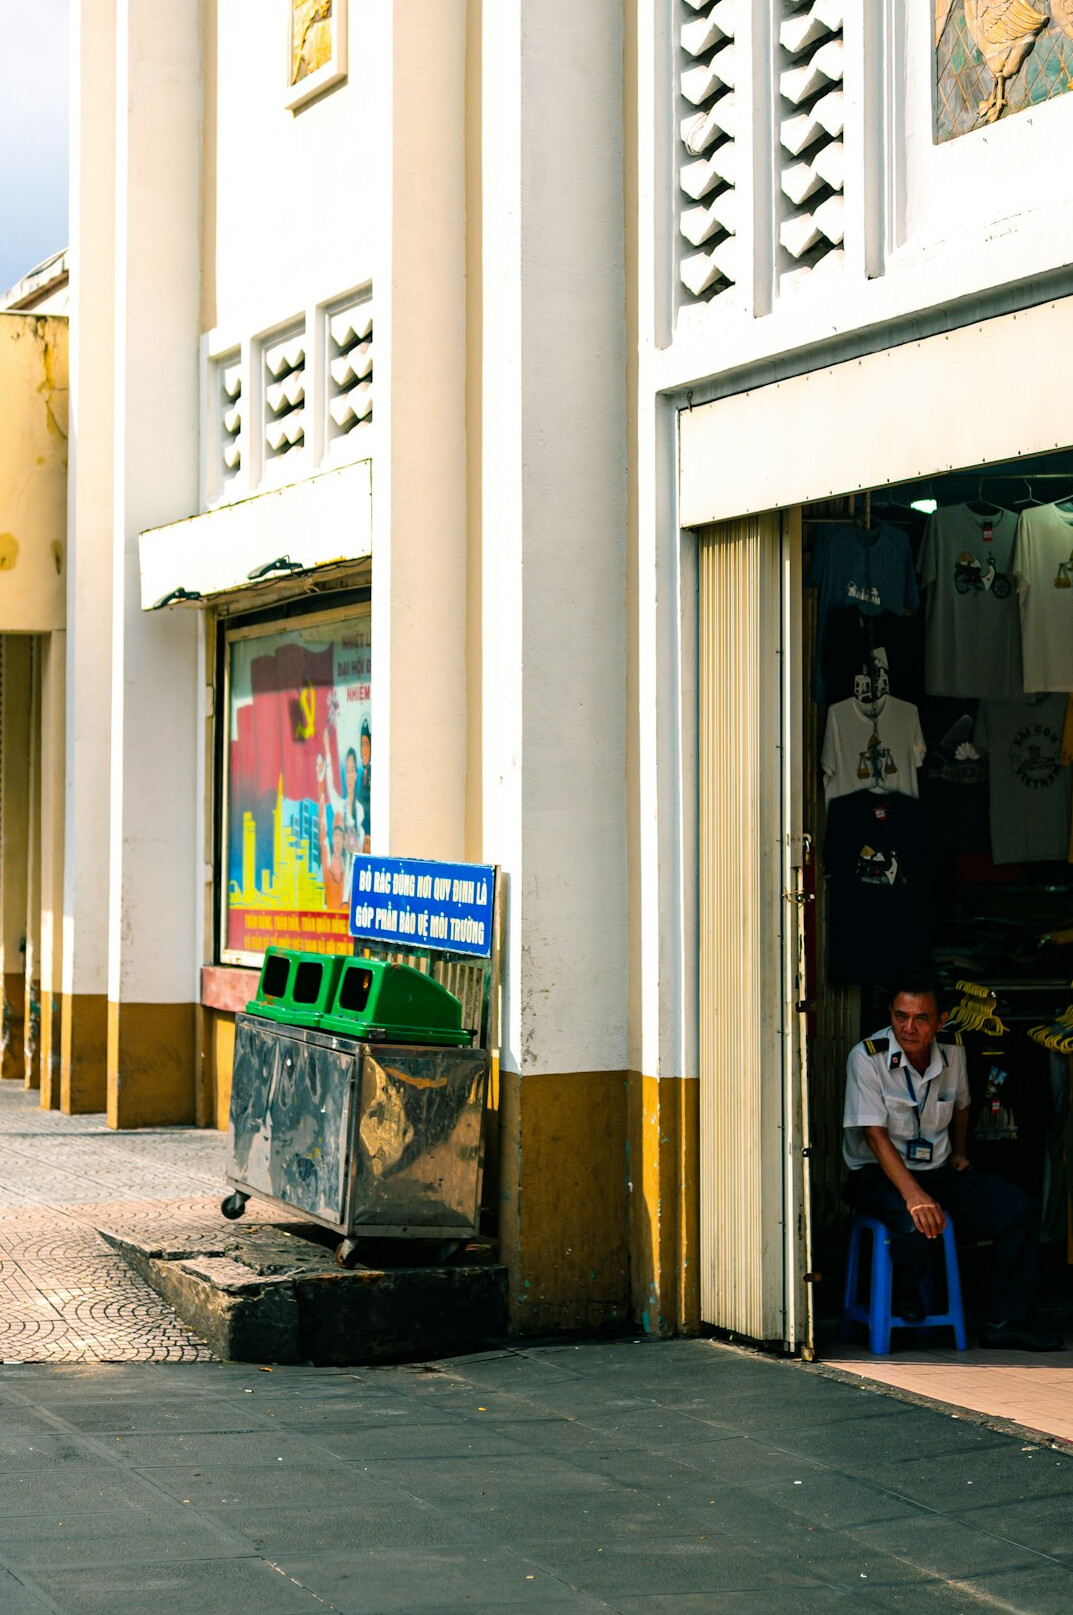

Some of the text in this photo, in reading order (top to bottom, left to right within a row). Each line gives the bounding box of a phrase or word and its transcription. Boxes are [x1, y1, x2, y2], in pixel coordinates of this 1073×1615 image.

[359, 864, 488, 907] BỎ RÁC ĐÚNG NƠI QUY ĐỊNH LÀ
[355, 902, 374, 928] GÓP
[375, 901, 398, 932] PHẦN
[399, 905, 416, 935] BẢO
[417, 909, 429, 941] VỆ
[430, 912, 448, 940] MÔI
[450, 915, 485, 945] TRƯỜNG
